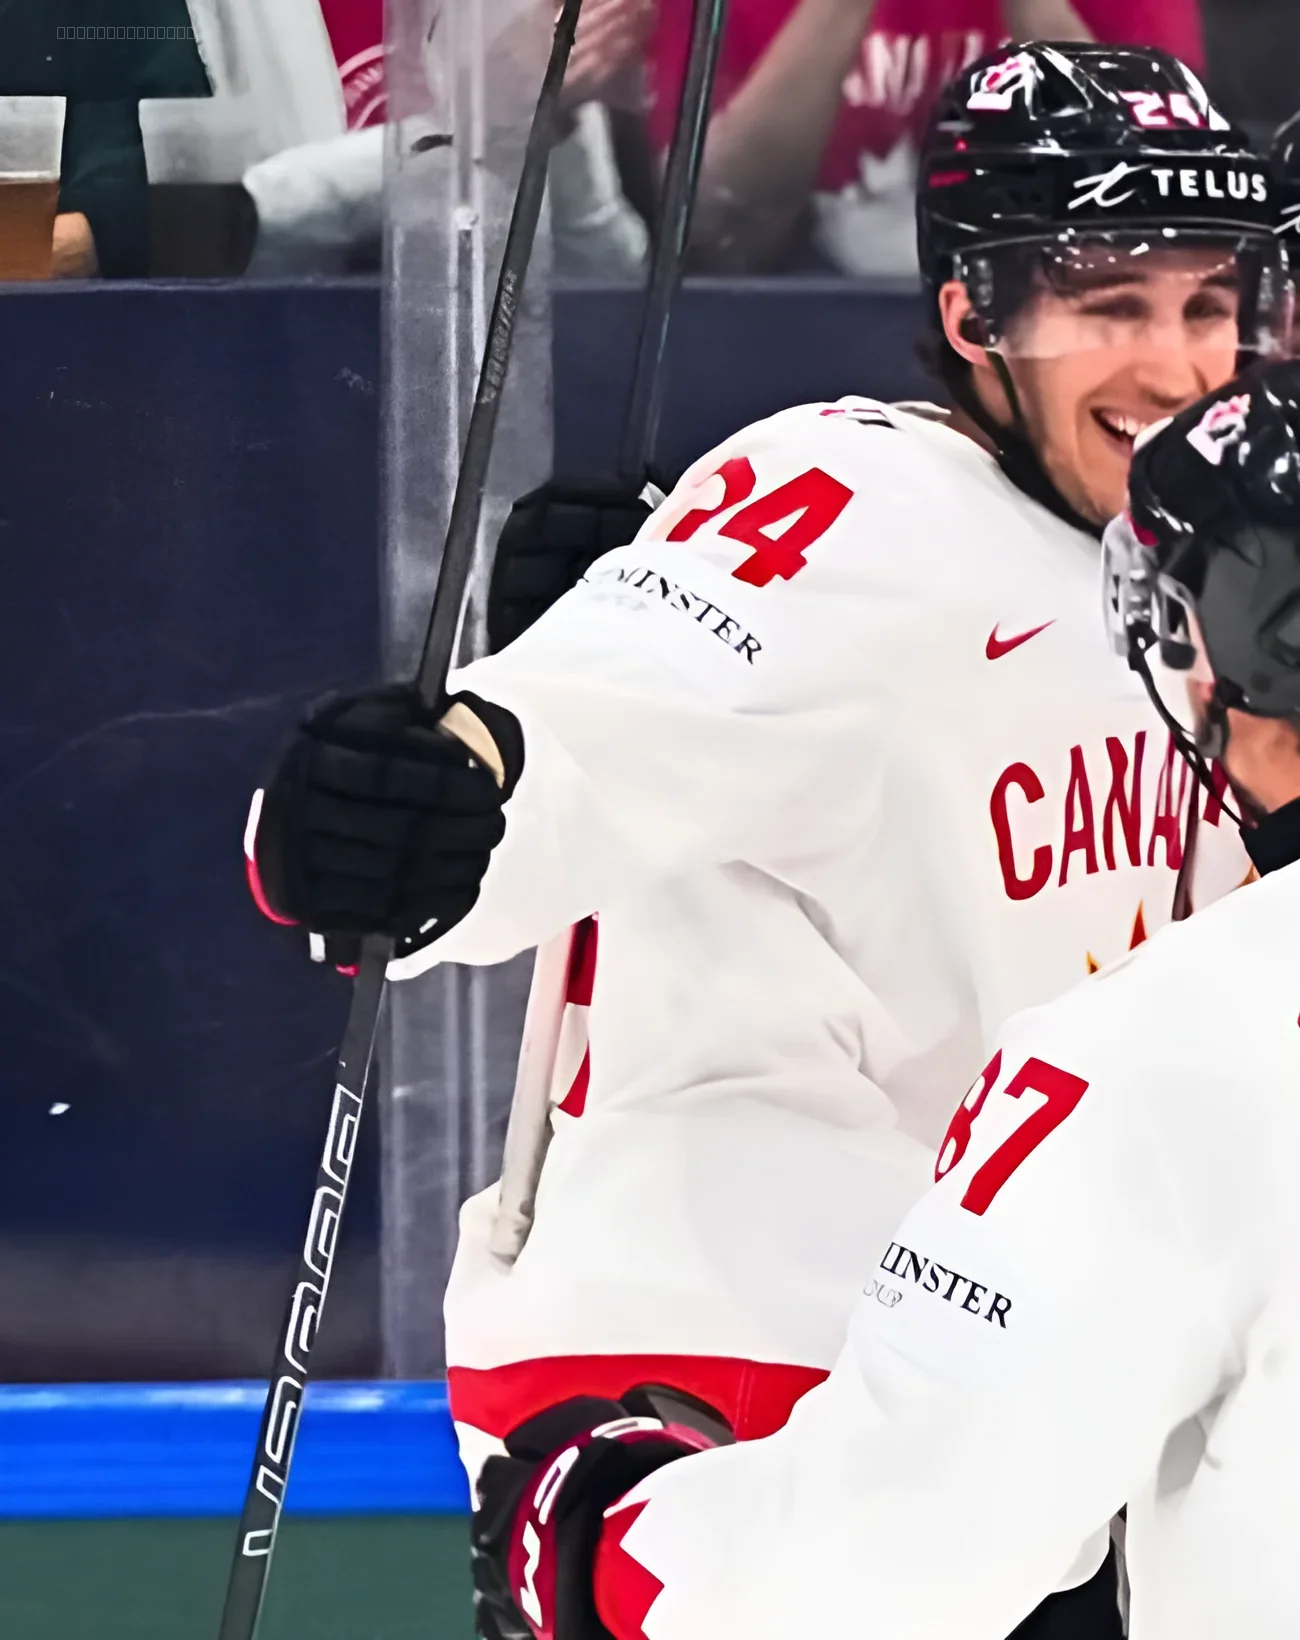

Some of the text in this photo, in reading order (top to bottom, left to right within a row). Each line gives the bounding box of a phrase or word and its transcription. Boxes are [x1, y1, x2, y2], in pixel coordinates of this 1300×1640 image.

[1151, 169, 1268, 202] TELUS
[990, 730, 1240, 901] CANA
[934, 1048, 1089, 1216] 87
